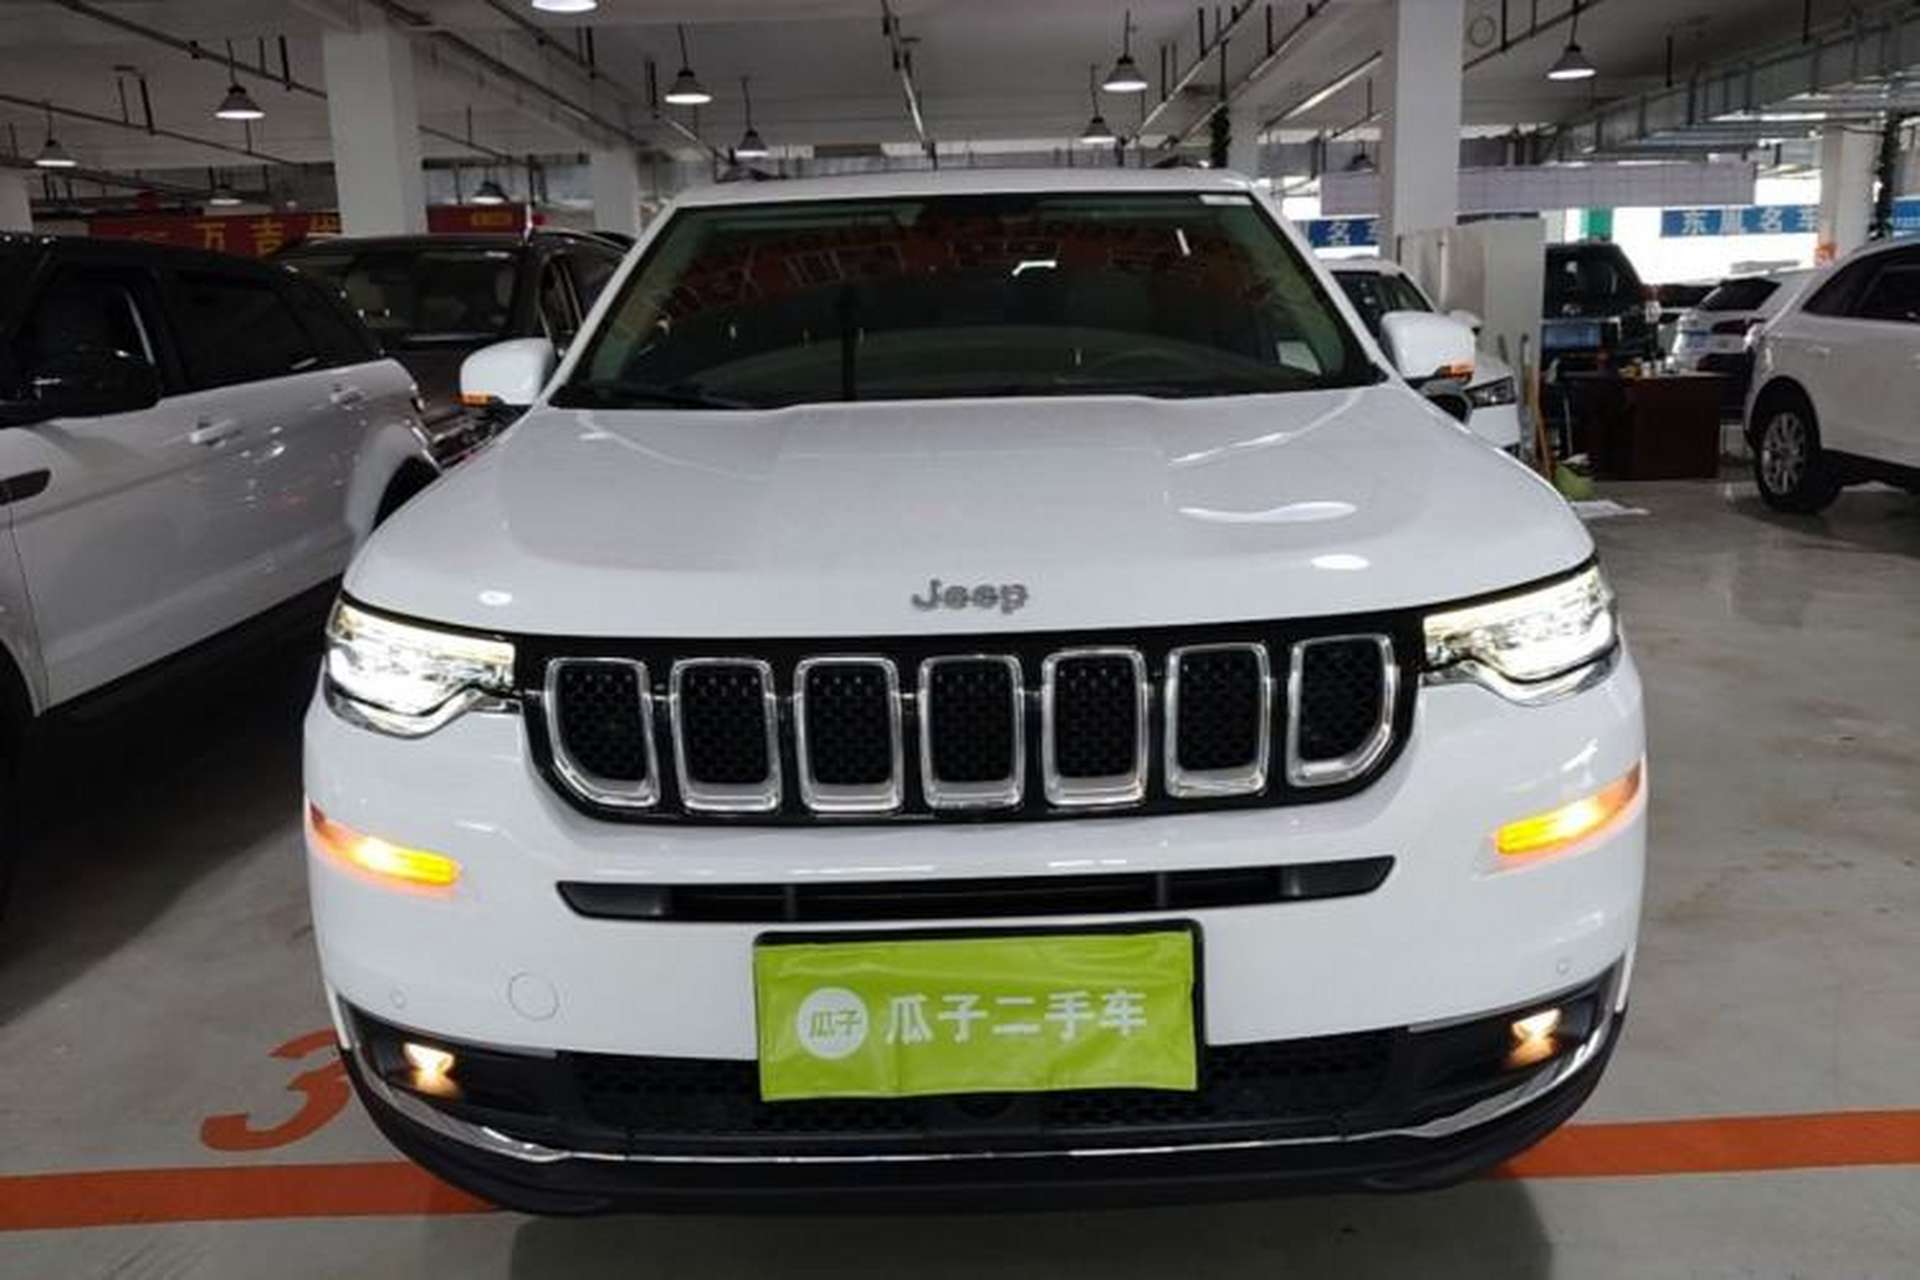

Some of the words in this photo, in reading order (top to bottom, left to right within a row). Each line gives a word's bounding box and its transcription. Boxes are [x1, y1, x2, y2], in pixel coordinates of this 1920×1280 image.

[911, 578, 1028, 615] Jeep
[808, 1008, 862, 1038] 瓜子
[885, 989, 1147, 1045] 瓜子二手车
[202, 1027, 352, 1152] 3
